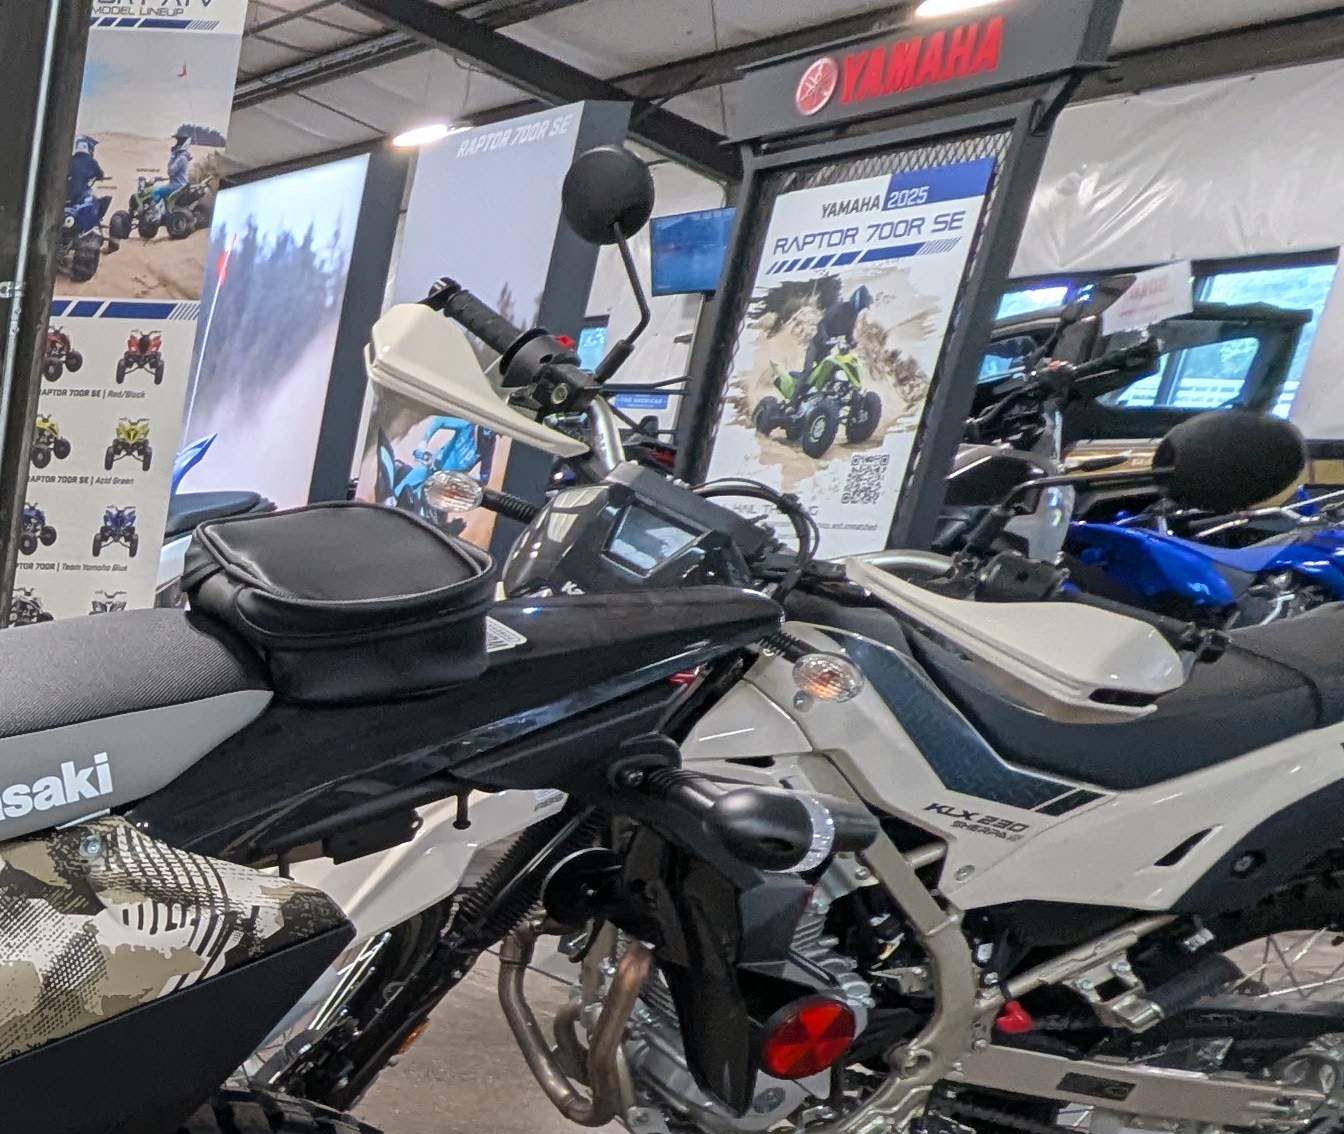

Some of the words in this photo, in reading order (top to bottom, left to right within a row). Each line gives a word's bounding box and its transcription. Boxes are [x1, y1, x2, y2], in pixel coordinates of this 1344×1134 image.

[92, 6, 135, 16] MODEL
[138, 7, 185, 17] LINEUP
[840, 14, 1005, 106] YAMAHA
[456, 129, 513, 158] RAPTOR
[510, 120, 551, 146] 700R
[549, 114, 574, 136] SE
[820, 194, 881, 220] YAMAHA
[887, 186, 931, 209] 2025
[773, 225, 860, 256] RAPTOR
[866, 217, 925, 243] 700R
[931, 210, 967, 234] SE
[39, 389, 67, 398] APTOR
[923, 802, 980, 821] KLX
[977, 815, 1030, 833] 230
[950, 820, 1007, 839] SHERPA
